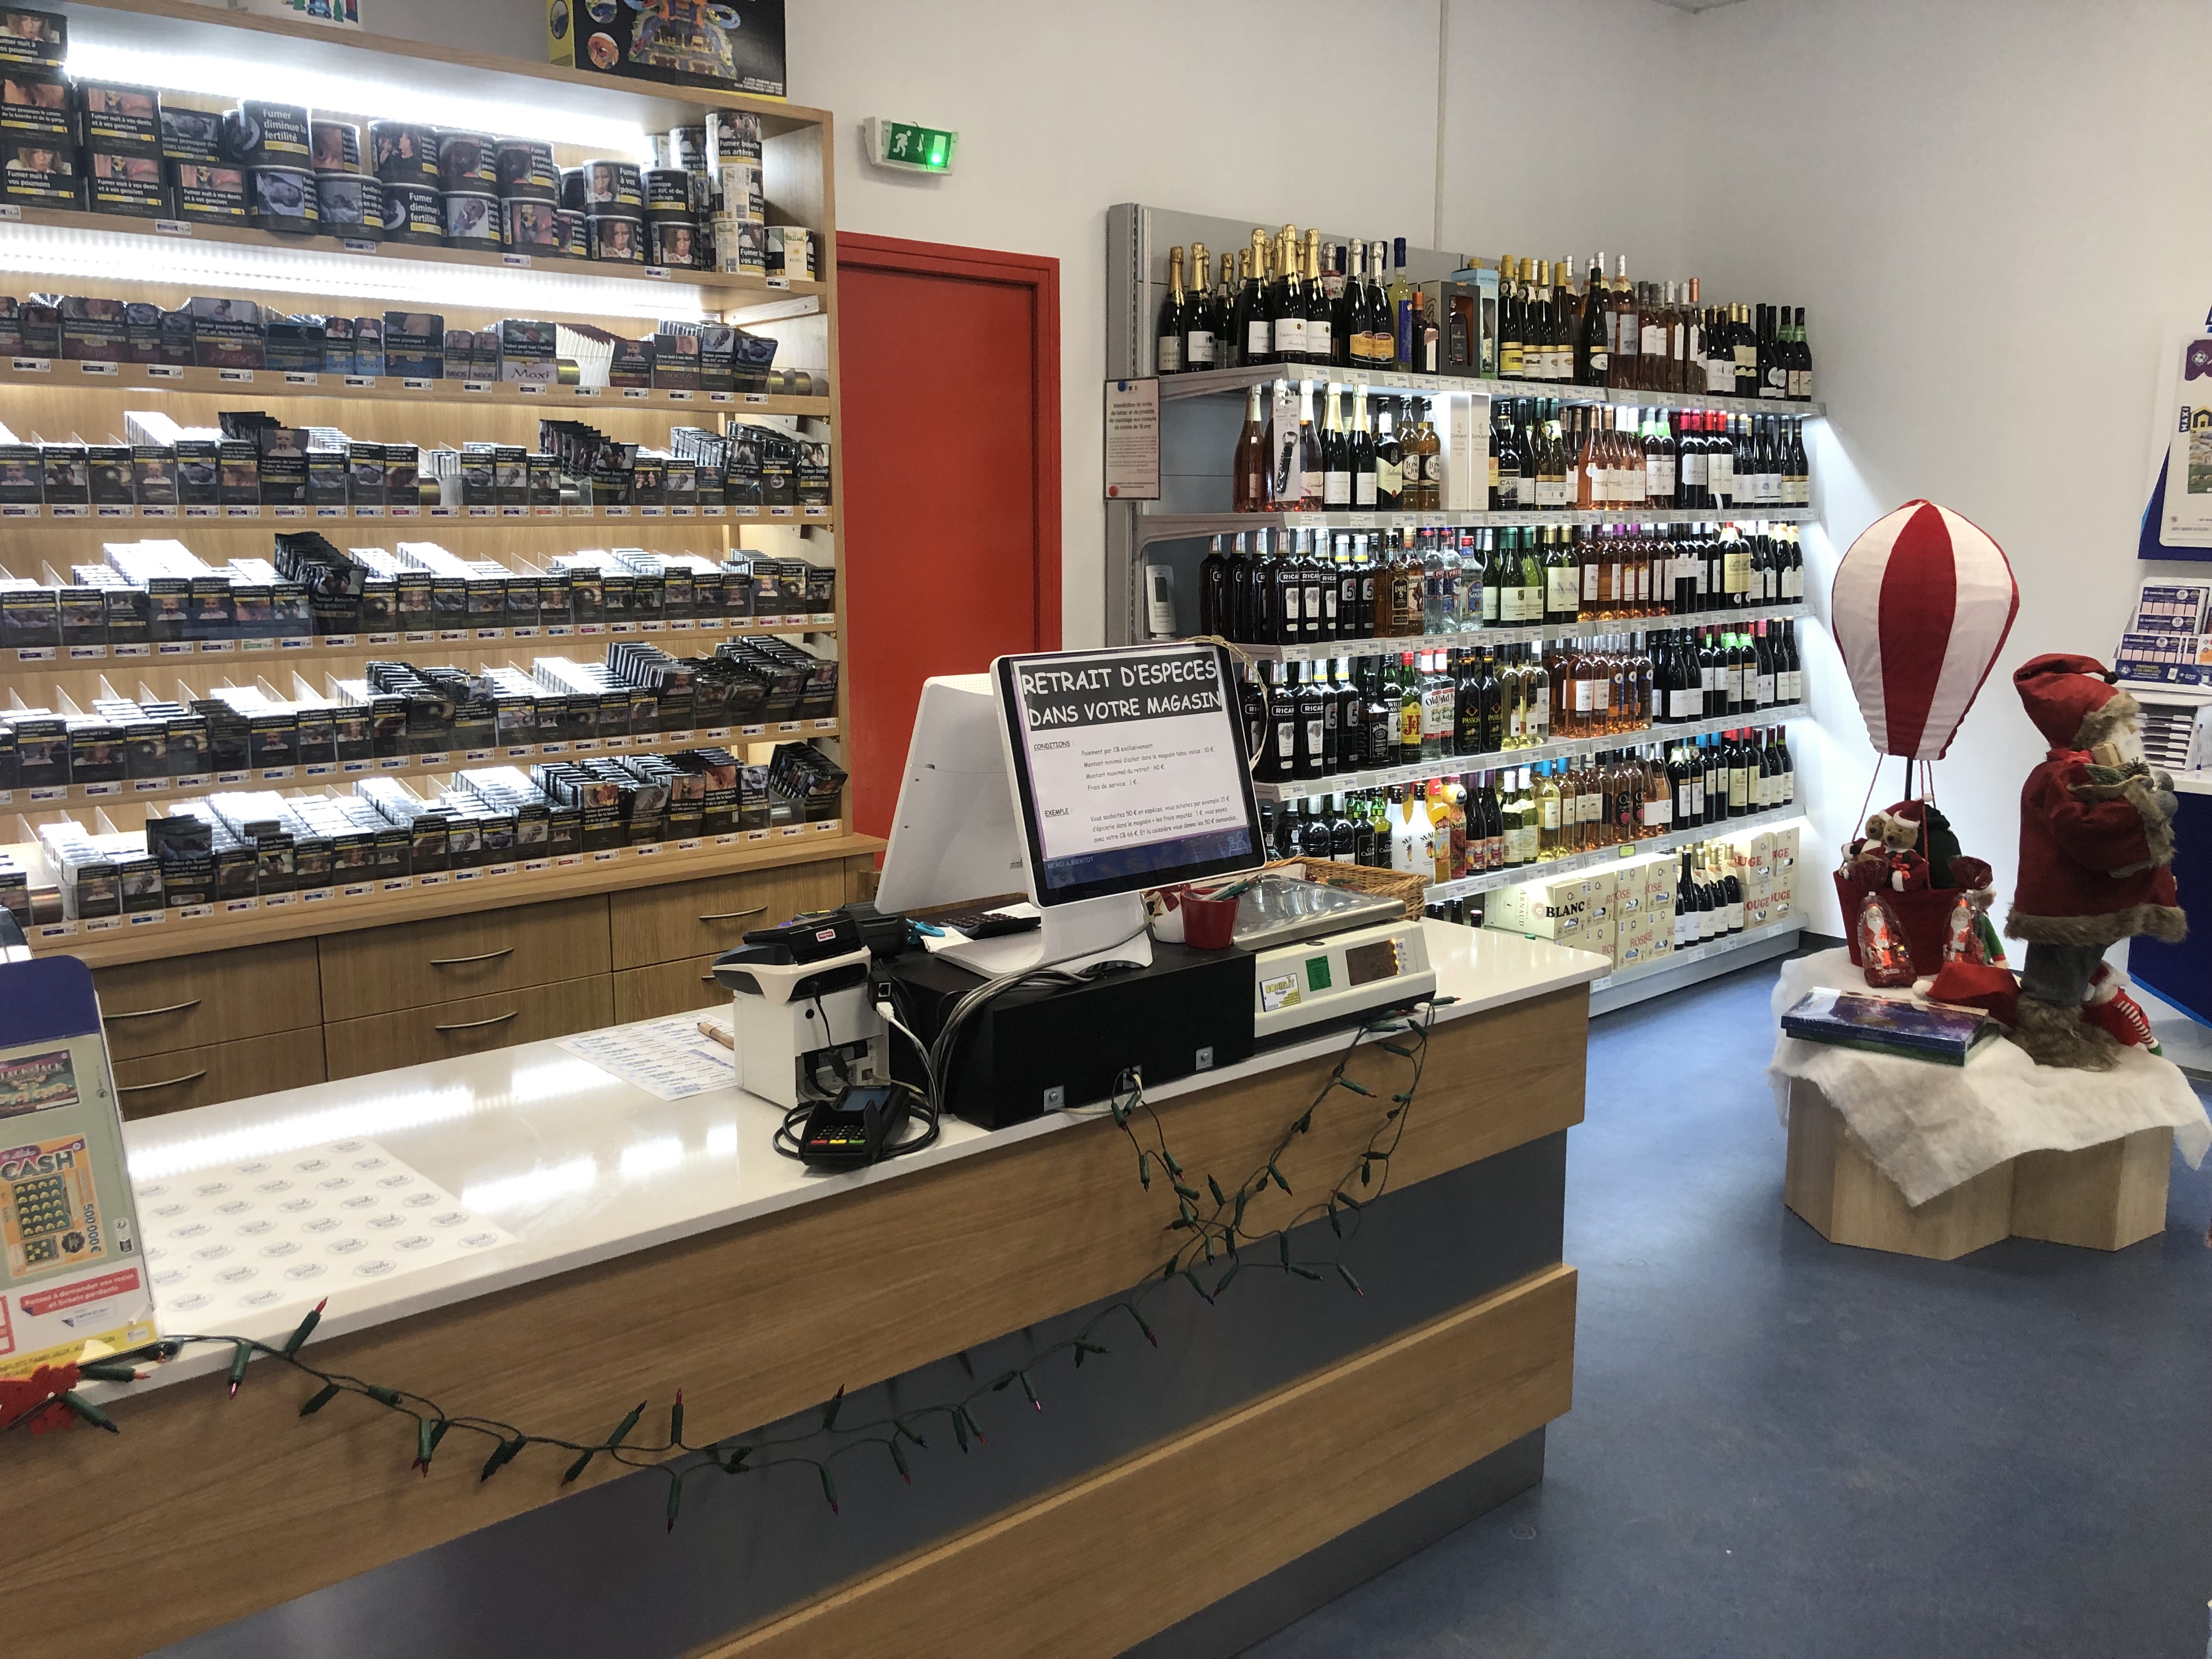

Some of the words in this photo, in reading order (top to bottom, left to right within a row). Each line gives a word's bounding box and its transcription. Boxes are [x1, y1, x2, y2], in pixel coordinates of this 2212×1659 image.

[263, 109, 291, 120] Fumer
[263, 119, 300, 131] diminue
[264, 129, 298, 142] fertilité
[409, 192, 432, 203] Fumer
[409, 203, 437, 214] diminue
[410, 213, 436, 224] fertilité
[740, 248, 758, 256] Fumer
[511, 368, 549, 379] Maxi
[2180, 407, 2190, 432] MAXI
[1020, 668, 1111, 695] RETRAIT
[1120, 659, 1217, 687] D'ESPECES
[1426, 697, 1437, 707] Old
[1028, 705, 1079, 726] DANS
[1084, 698, 1141, 720] VOTRE
[1147, 691, 1222, 714] MAGASIN
[1034, 740, 1070, 751] CONDITIONS
[1104, 757, 1122, 765] minimal
[1045, 808, 1069, 817] EXEMPLE
[1103, 812, 1125, 821] souhaitez
[1175, 801, 1193, 809] achetez
[1201, 797, 1220, 805] exemple
[1092, 825, 1115, 833] d'épicerie
[1133, 819, 1152, 827] magasin
[1175, 812, 1193, 821] imputés
[1545, 901, 1584, 918] BLANC
[1, 1150, 75, 1181] CASH
